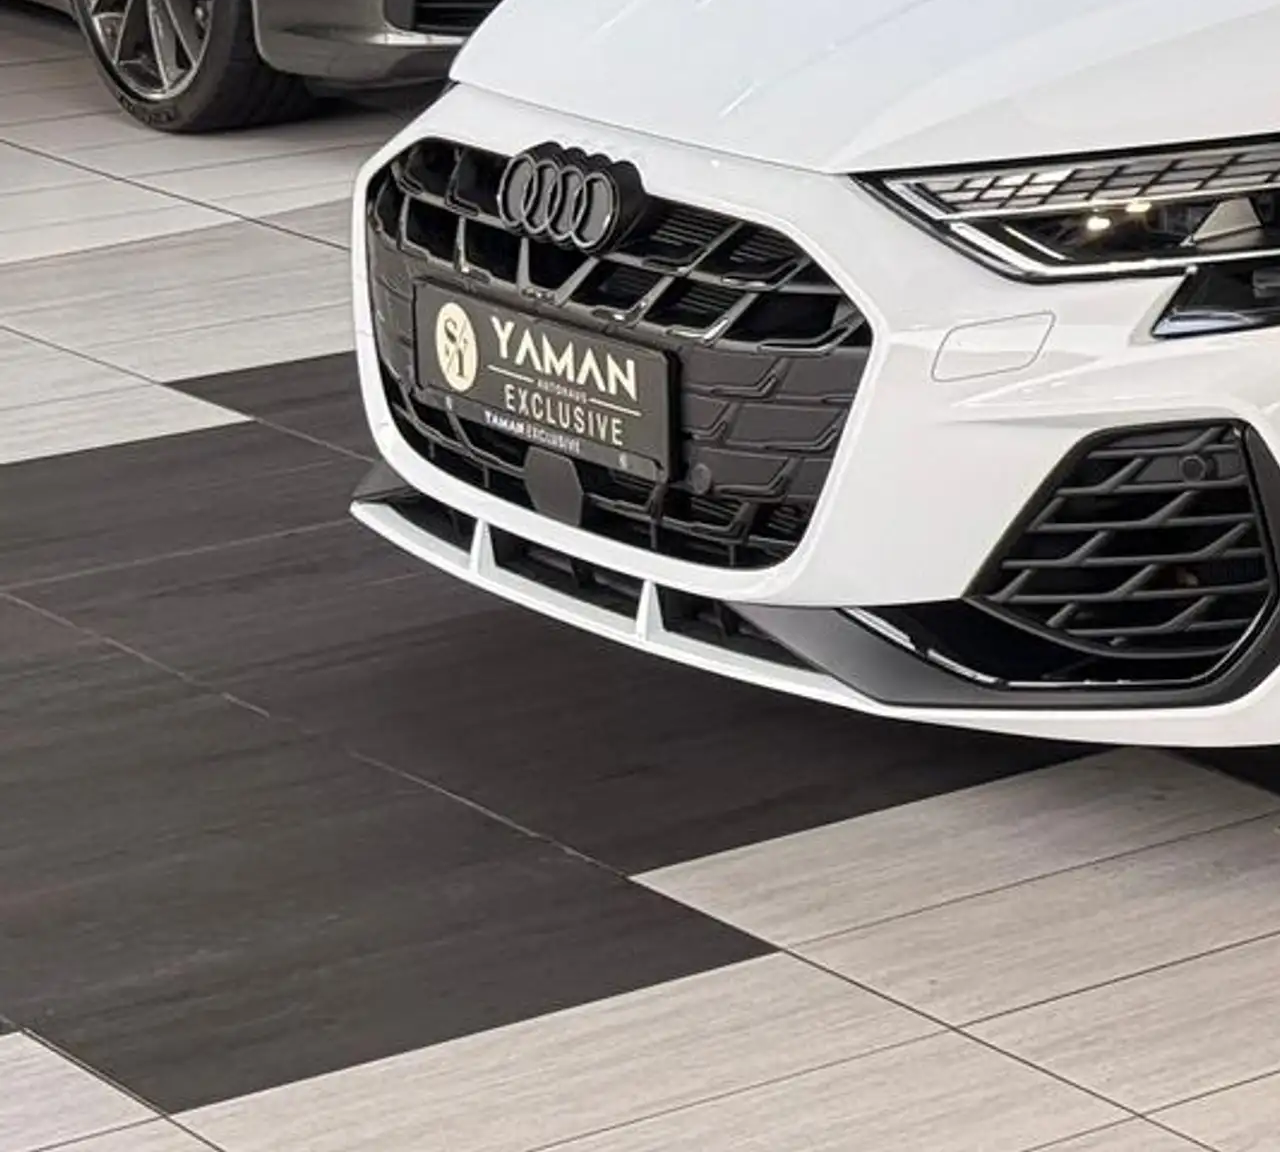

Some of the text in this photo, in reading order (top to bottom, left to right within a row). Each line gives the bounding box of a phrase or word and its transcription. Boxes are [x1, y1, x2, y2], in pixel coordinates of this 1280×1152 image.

[490, 315, 637, 403] YAMAN
[483, 410, 525, 434] YAMAN
[504, 384, 623, 446] EXCLUSIVE
